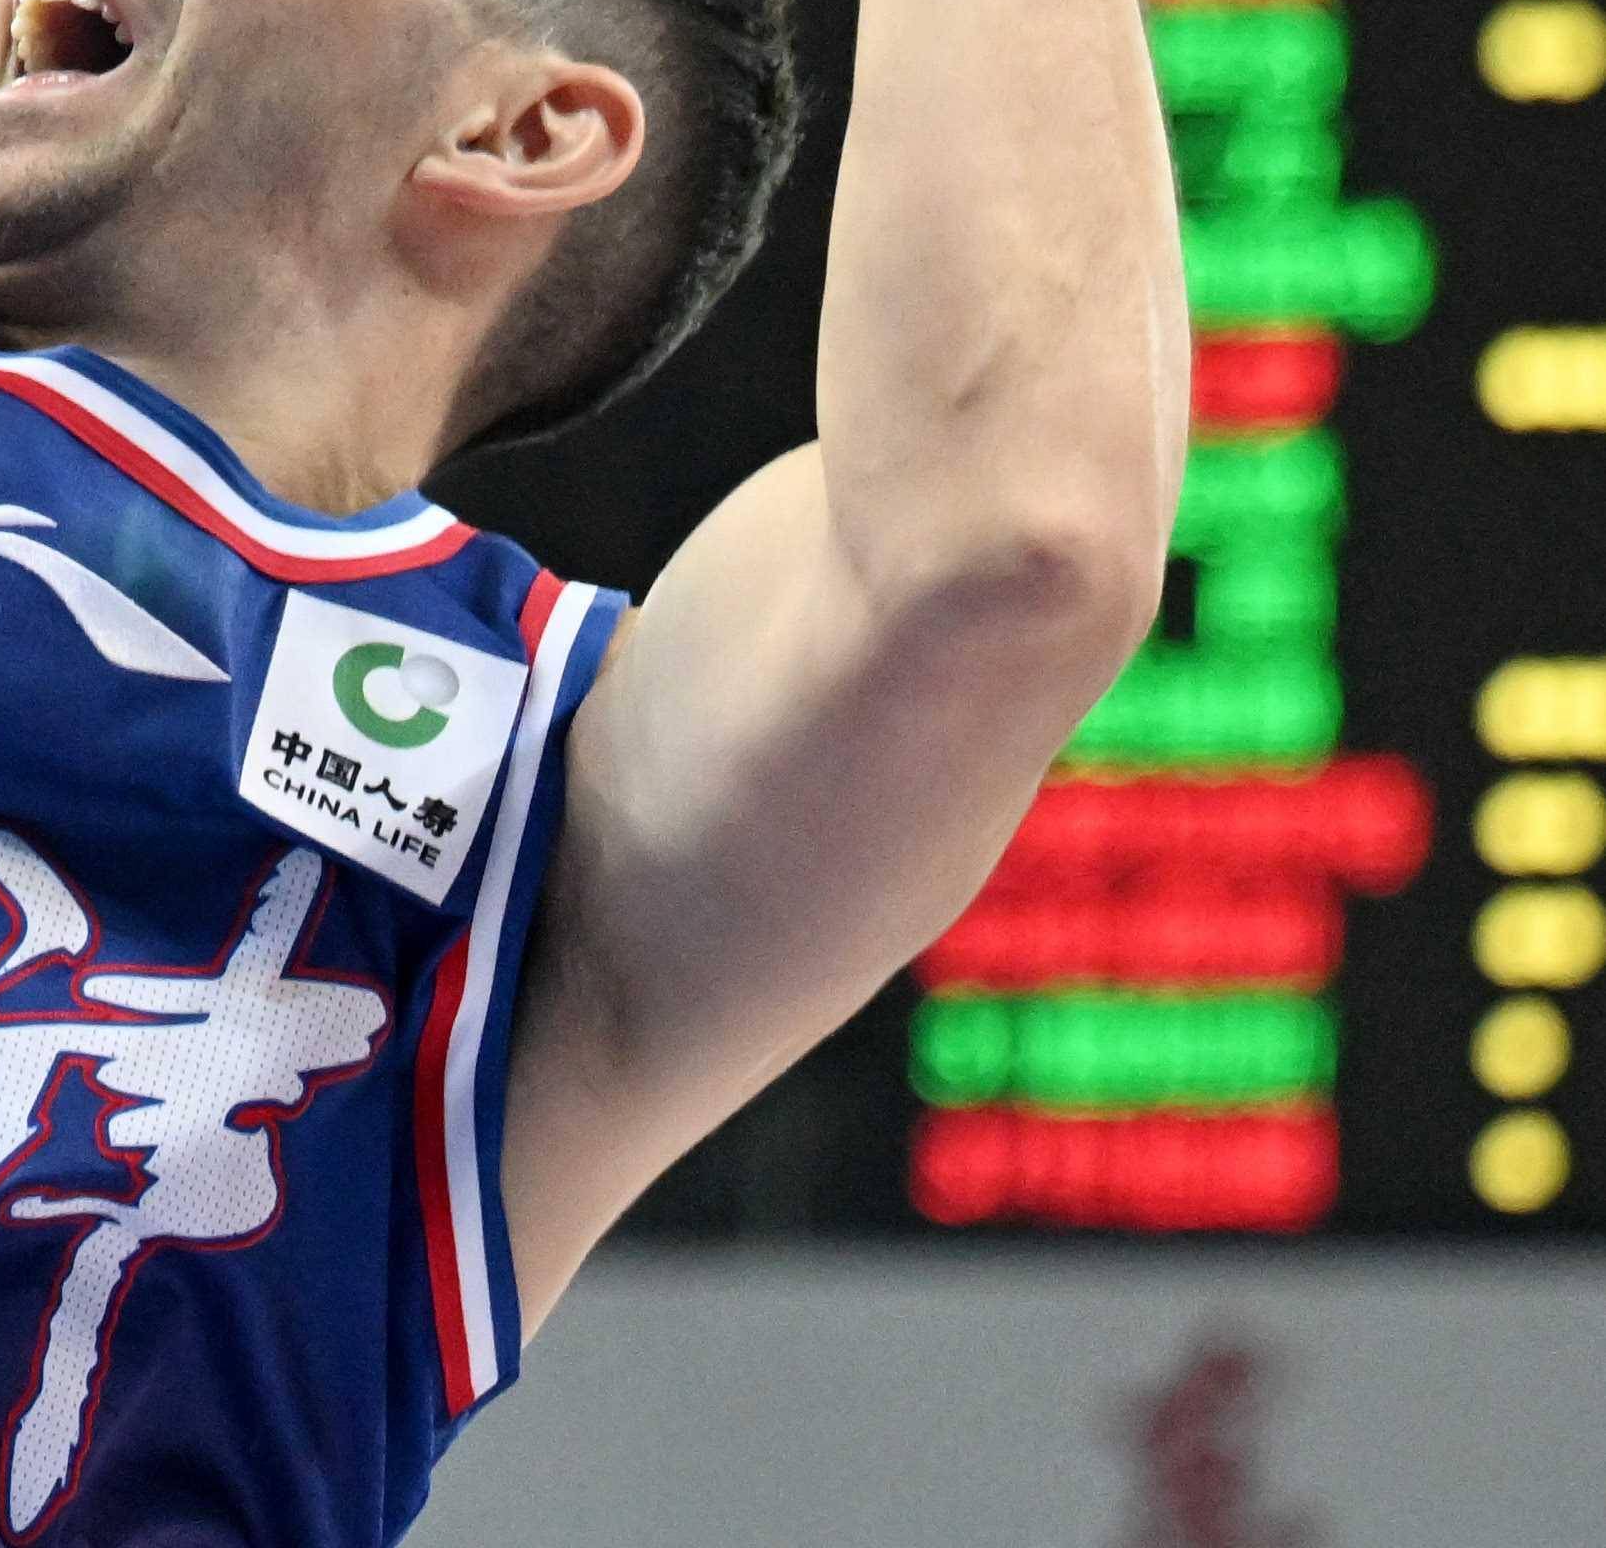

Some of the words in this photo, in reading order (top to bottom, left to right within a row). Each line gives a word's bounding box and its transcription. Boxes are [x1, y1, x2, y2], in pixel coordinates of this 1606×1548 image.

[263, 769, 361, 829] CHINA
[373, 819, 442, 870] LIFE
[271, 729, 459, 838] 中国人寿
